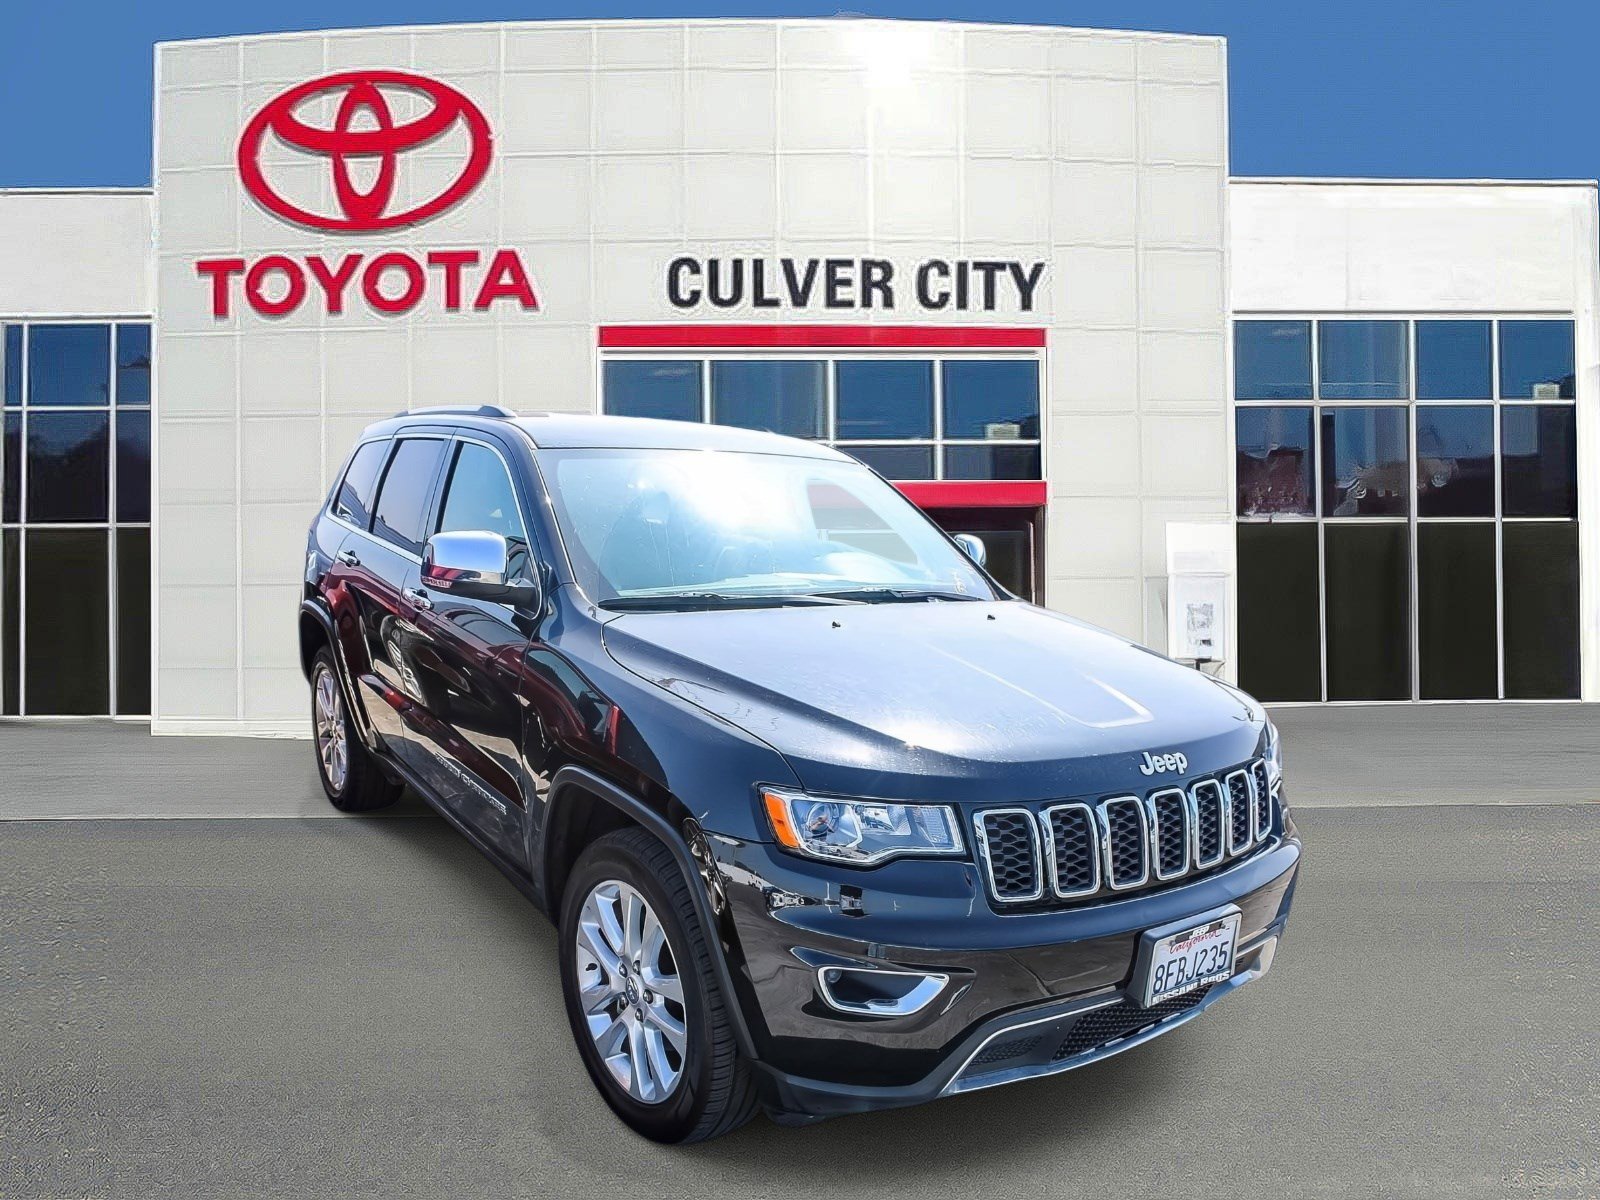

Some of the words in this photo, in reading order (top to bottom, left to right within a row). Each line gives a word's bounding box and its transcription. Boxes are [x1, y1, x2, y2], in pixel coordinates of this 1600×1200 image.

[195, 249, 539, 318] TOYOTA
[667, 256, 895, 309] CULVER
[916, 258, 1045, 311] CITY
[1139, 751, 1188, 776] Jeep
[1152, 940, 1230, 995] 8FBJ235
